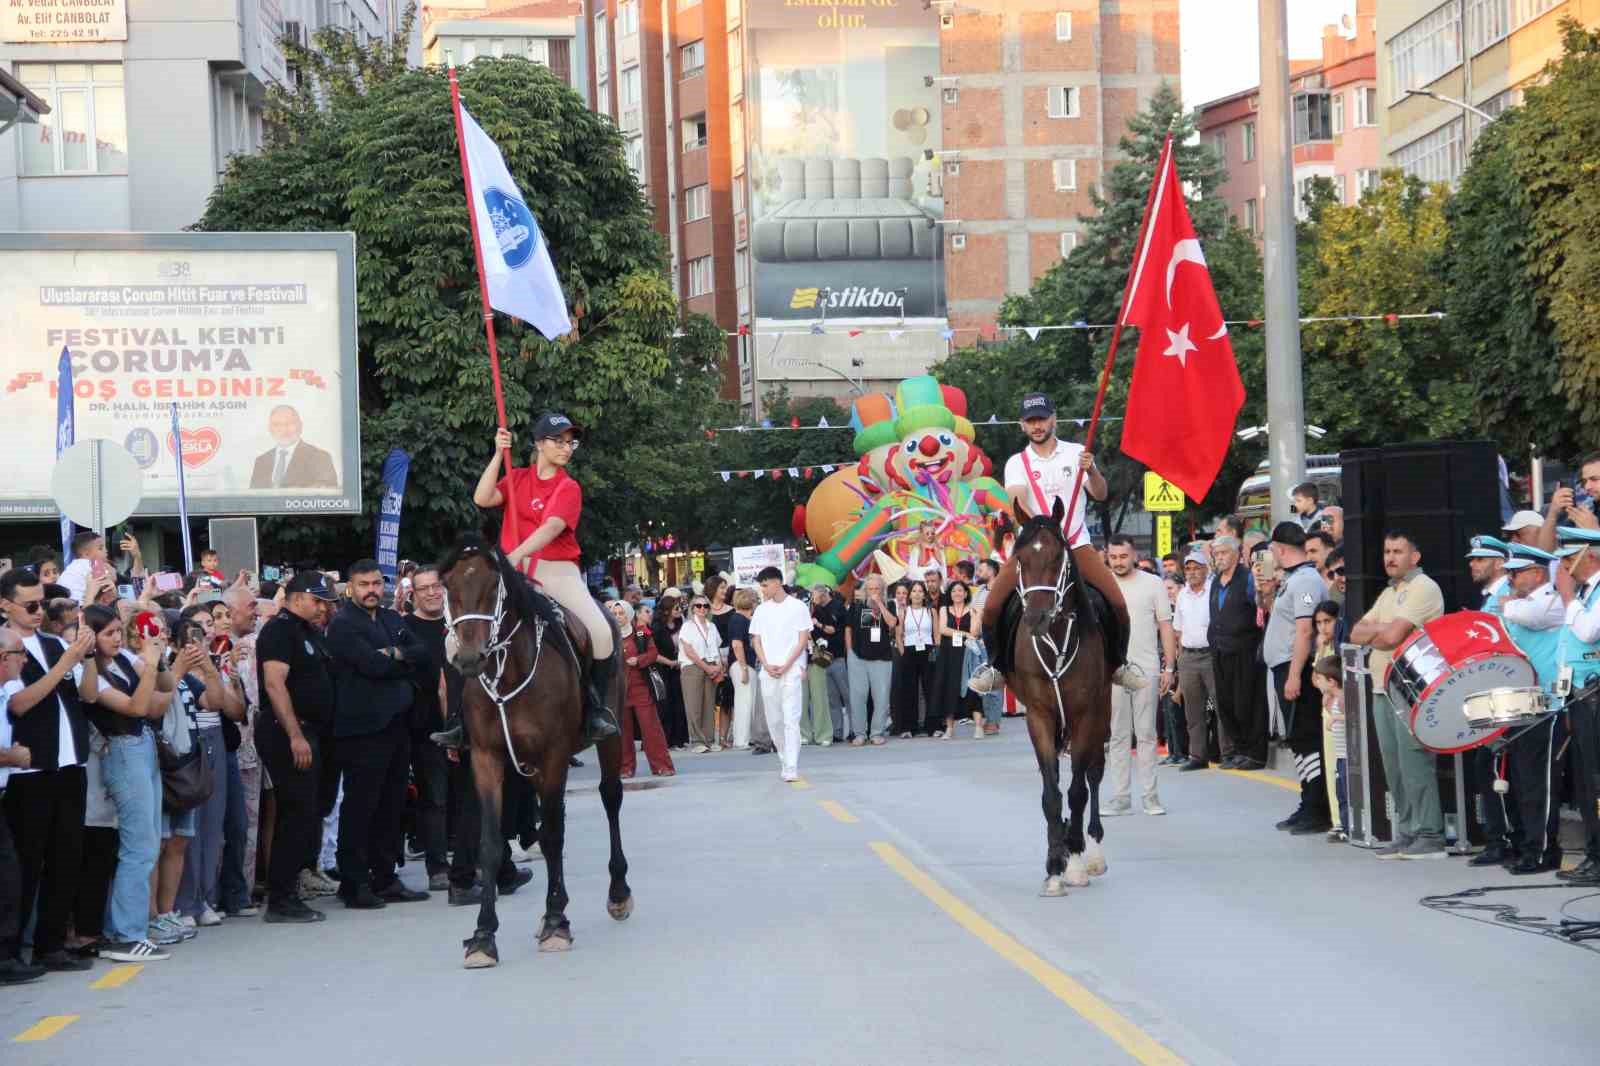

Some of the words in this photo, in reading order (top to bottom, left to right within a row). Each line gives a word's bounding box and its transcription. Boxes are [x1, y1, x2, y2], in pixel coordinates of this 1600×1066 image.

[17, 12, 31, 25] Av.
[35, 12, 52, 24] Elif
[56, 11, 111, 24] CANBOLAT
[817, 7, 867, 29] olur.
[122, 287, 165, 304] Çorum
[230, 289, 245, 302] ve
[47, 327, 188, 346] FESTİVAL
[198, 326, 285, 345] KENTİ
[132, 376, 287, 399] GELDİNİZ
